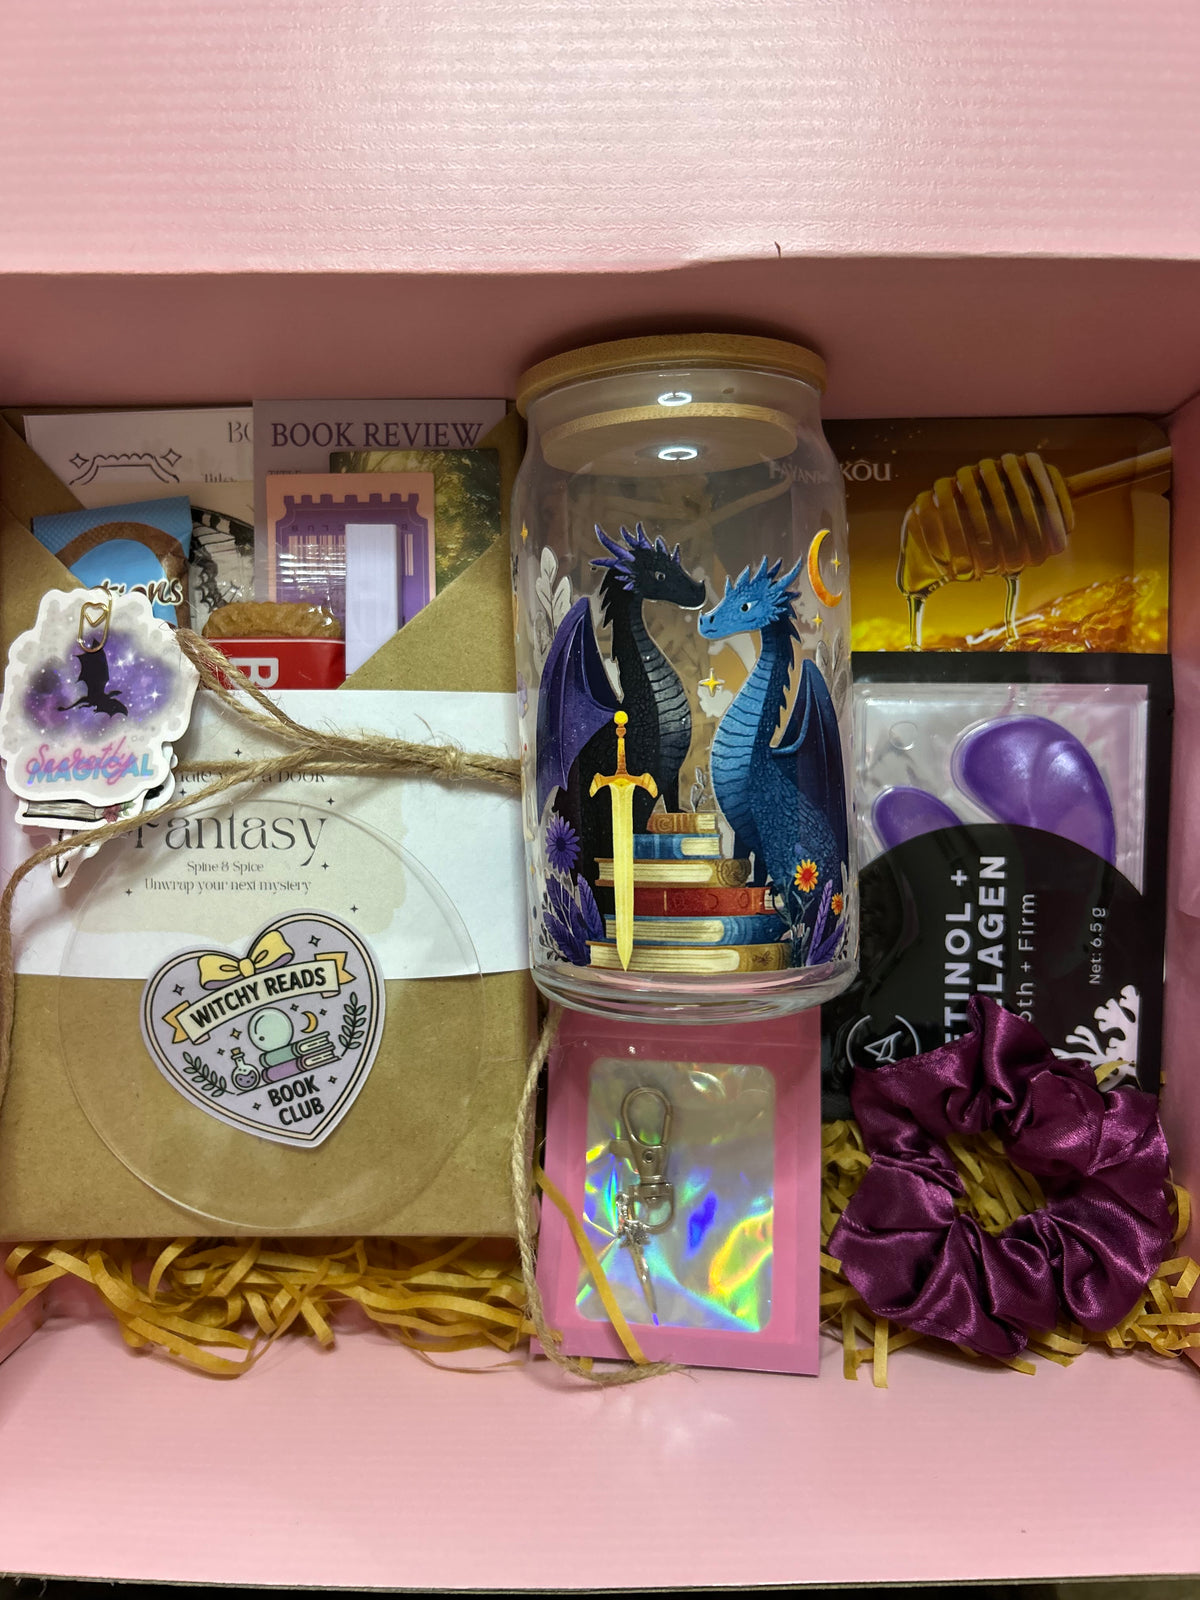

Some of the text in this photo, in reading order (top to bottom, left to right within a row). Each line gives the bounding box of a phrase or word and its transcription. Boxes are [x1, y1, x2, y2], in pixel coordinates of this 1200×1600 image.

[271, 422, 483, 448] BOOK REVIEW
[27, 753, 154, 787] MAGICAL
[187, 861, 264, 875] Spine & Spice
[951, 869, 967, 886] +
[145, 878, 312, 895] Unwrap your next mystery
[1018, 894, 1035, 951] Firm
[1088, 907, 1106, 984] Net: 6.5 g
[190, 967, 327, 1028] WITCHY READS
[267, 1075, 320, 1107] BOOK
[278, 1097, 325, 1126] CLUB
